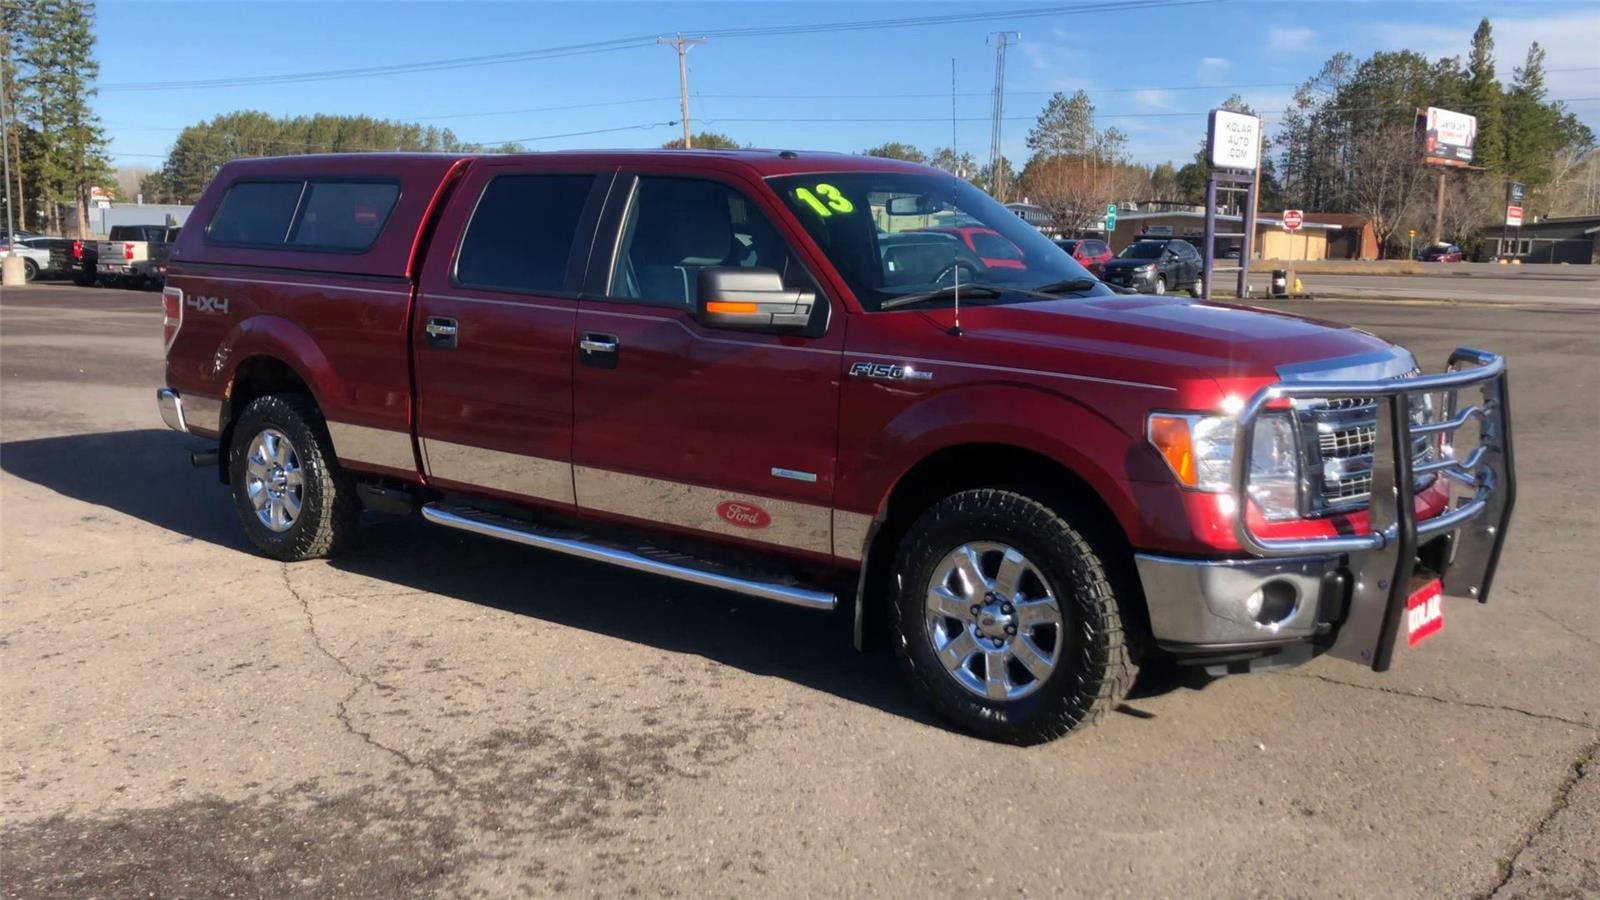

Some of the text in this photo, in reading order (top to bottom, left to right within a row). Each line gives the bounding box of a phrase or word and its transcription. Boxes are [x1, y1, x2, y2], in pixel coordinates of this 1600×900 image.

[1224, 122, 1252, 134] KOLAR
[1227, 135, 1249, 147] AUTO
[796, 183, 853, 216] 13
[726, 503, 759, 524] Ford
